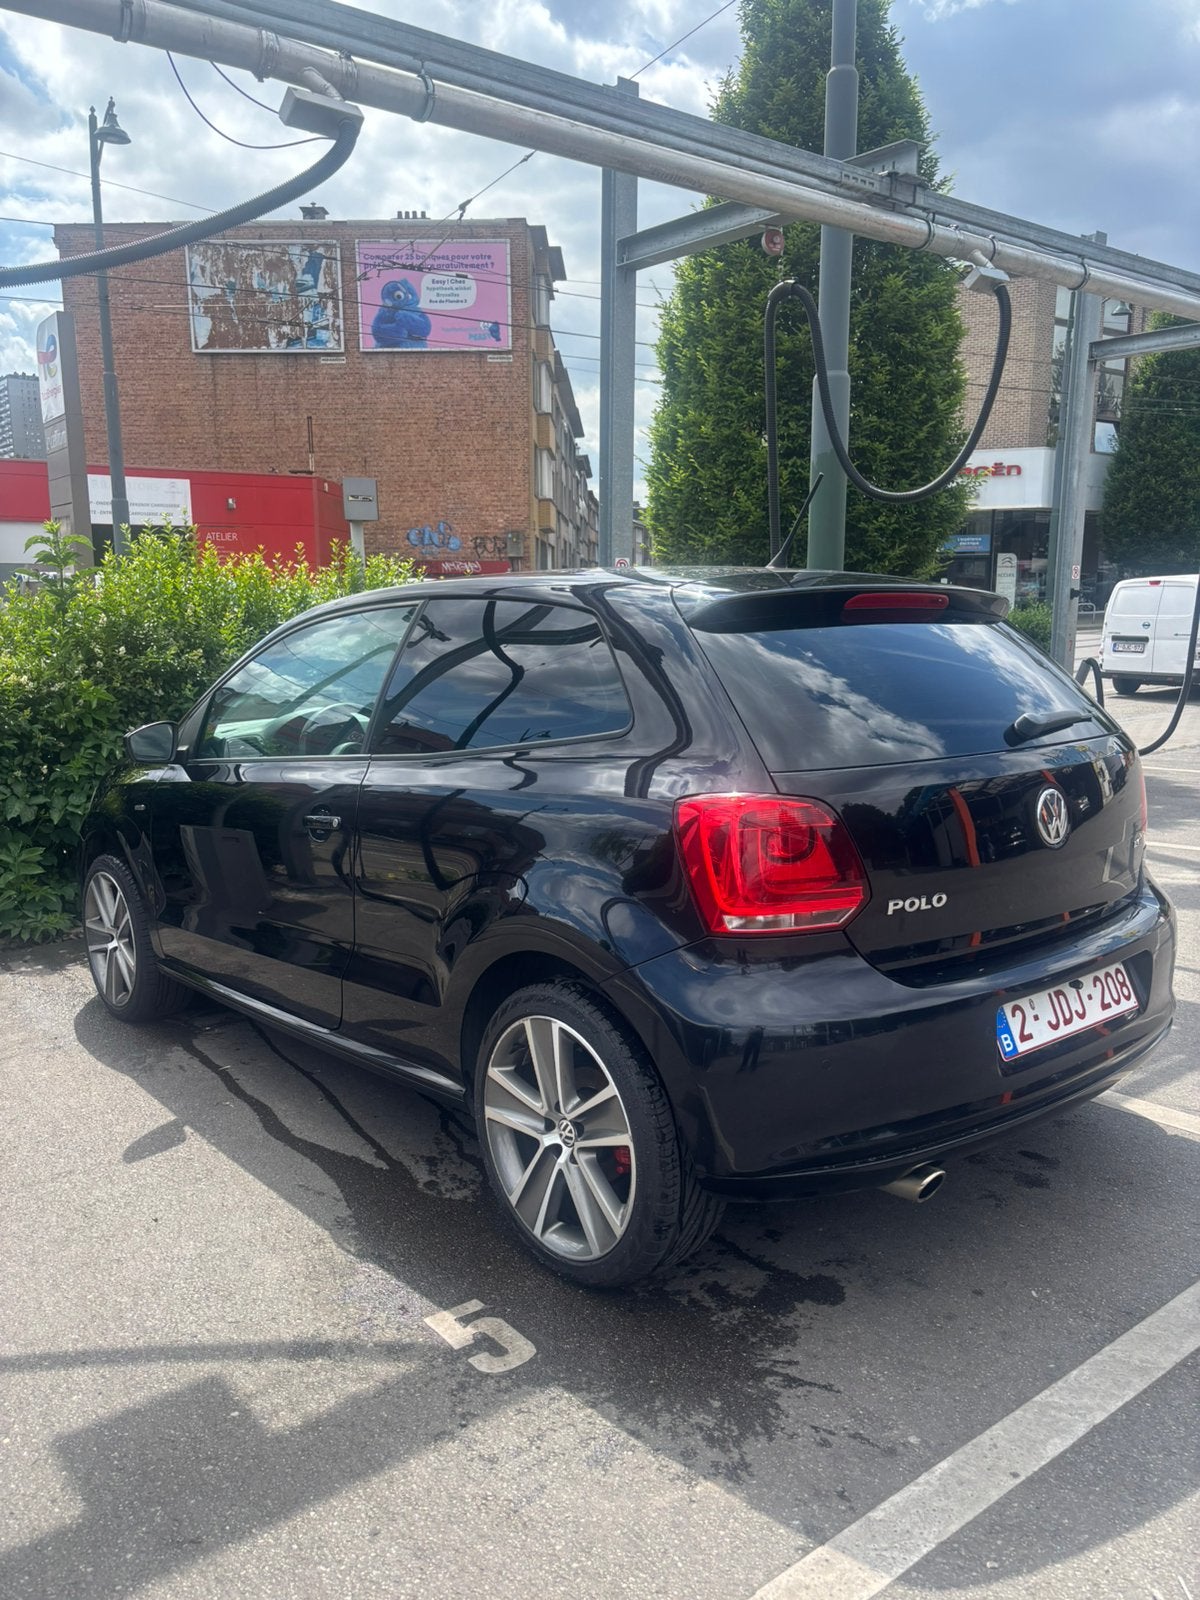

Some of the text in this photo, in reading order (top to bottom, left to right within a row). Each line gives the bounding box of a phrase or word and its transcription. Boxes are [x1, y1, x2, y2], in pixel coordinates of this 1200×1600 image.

[451, 254, 470, 263] pour
[206, 532, 238, 541] ATELIER
[887, 892, 947, 915] POLO
[1010, 967, 1132, 1044] 2-JDJ-208
[1001, 1034, 1014, 1052] B
[423, 1298, 537, 1374] 5
